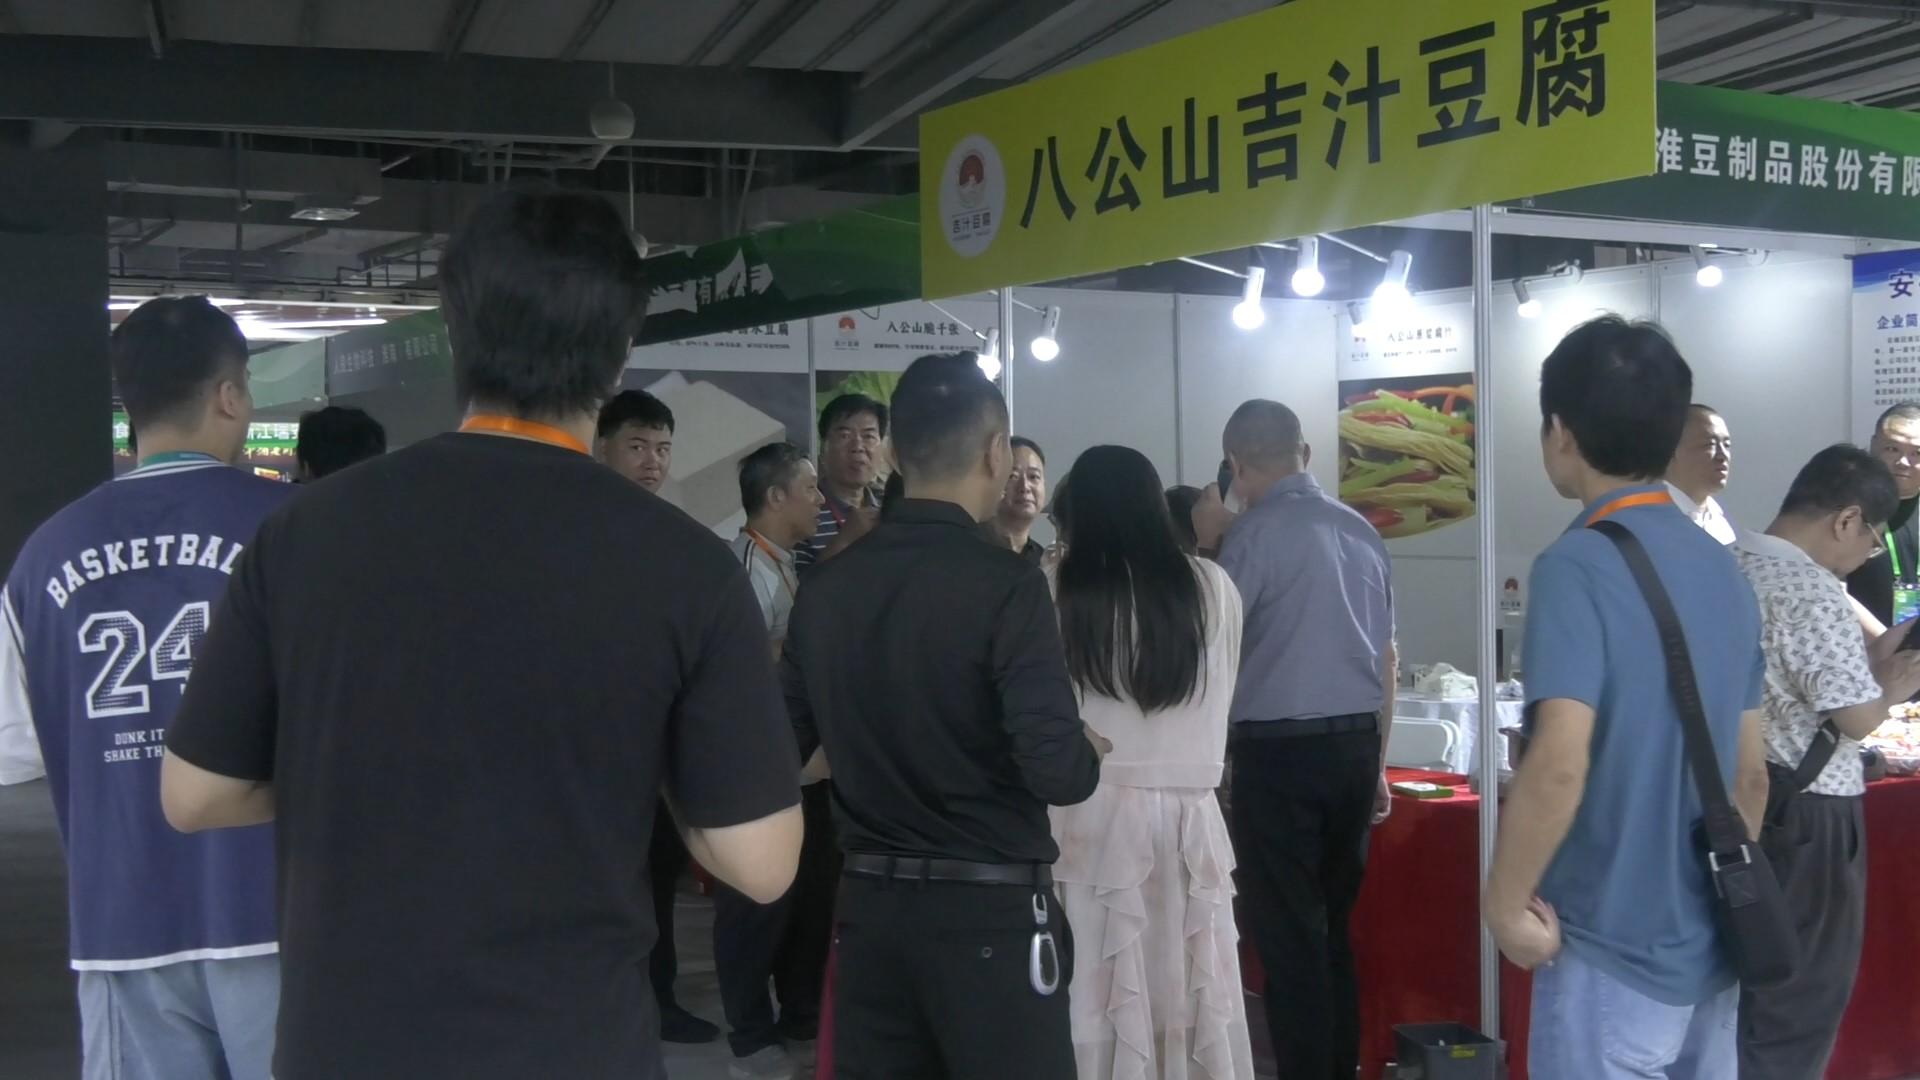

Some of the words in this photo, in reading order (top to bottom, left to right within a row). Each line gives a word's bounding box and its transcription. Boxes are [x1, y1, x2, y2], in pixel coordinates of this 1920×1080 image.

[1018, 0, 1612, 230] 八公山吉汁豆腐
[77, 601, 210, 719] 24
[104, 746, 140, 763] SHAKE
[144, 745, 166, 758] TH
